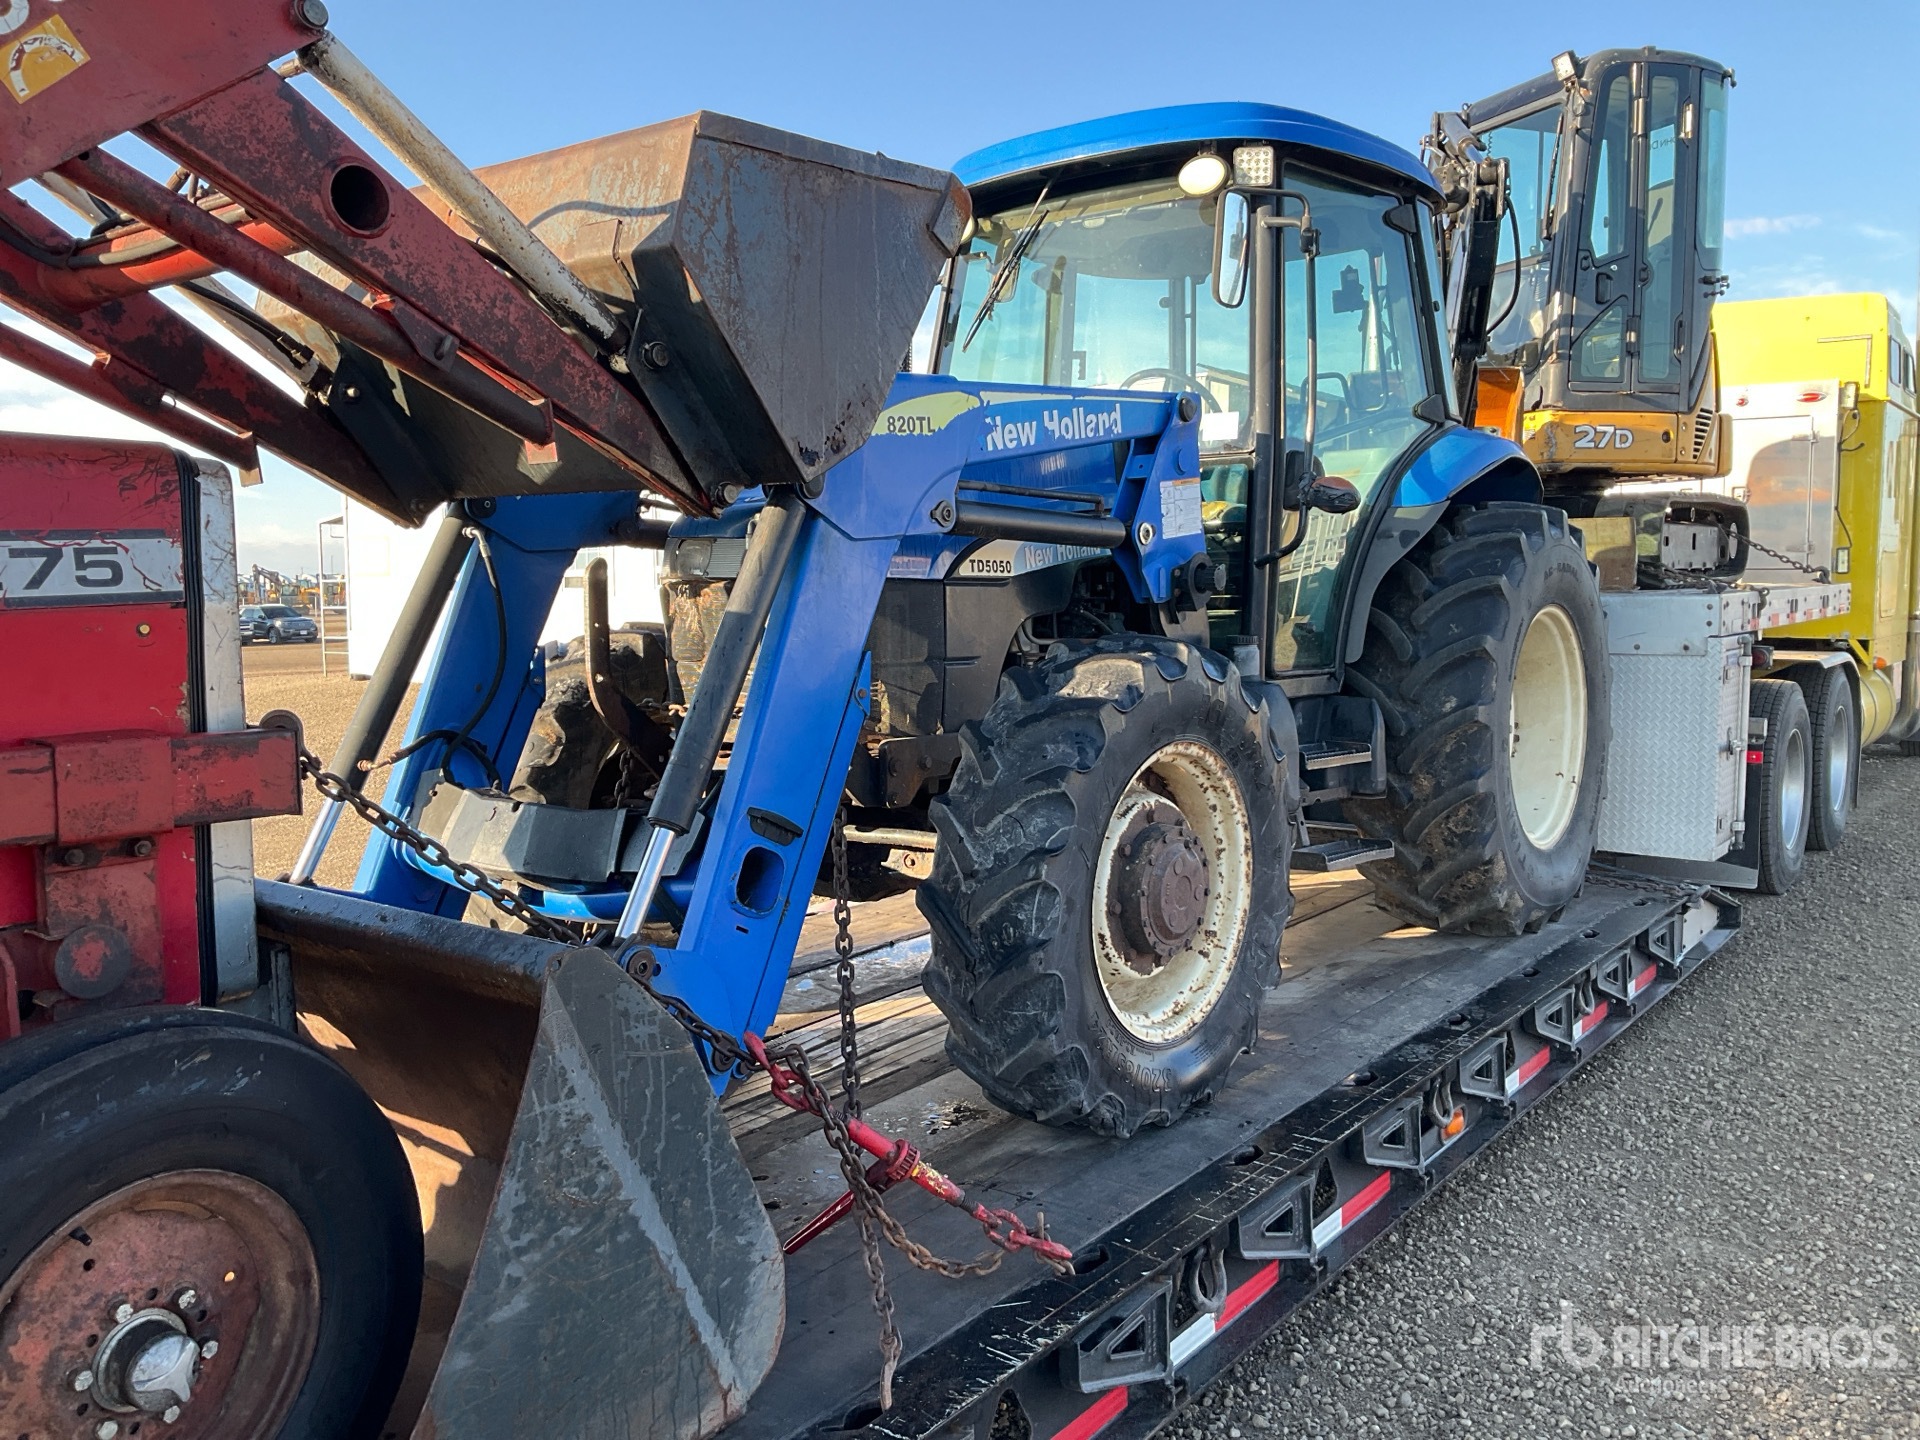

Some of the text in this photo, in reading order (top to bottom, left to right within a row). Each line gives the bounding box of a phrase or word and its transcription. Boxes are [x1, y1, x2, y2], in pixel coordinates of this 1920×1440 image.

[887, 416, 936, 433] 820TL
[985, 415, 1037, 451] New
[1574, 424, 1634, 448] 27D
[0, 547, 123, 591] 75
[969, 559, 1012, 573] TD5050
[1024, 545, 1054, 569] New
